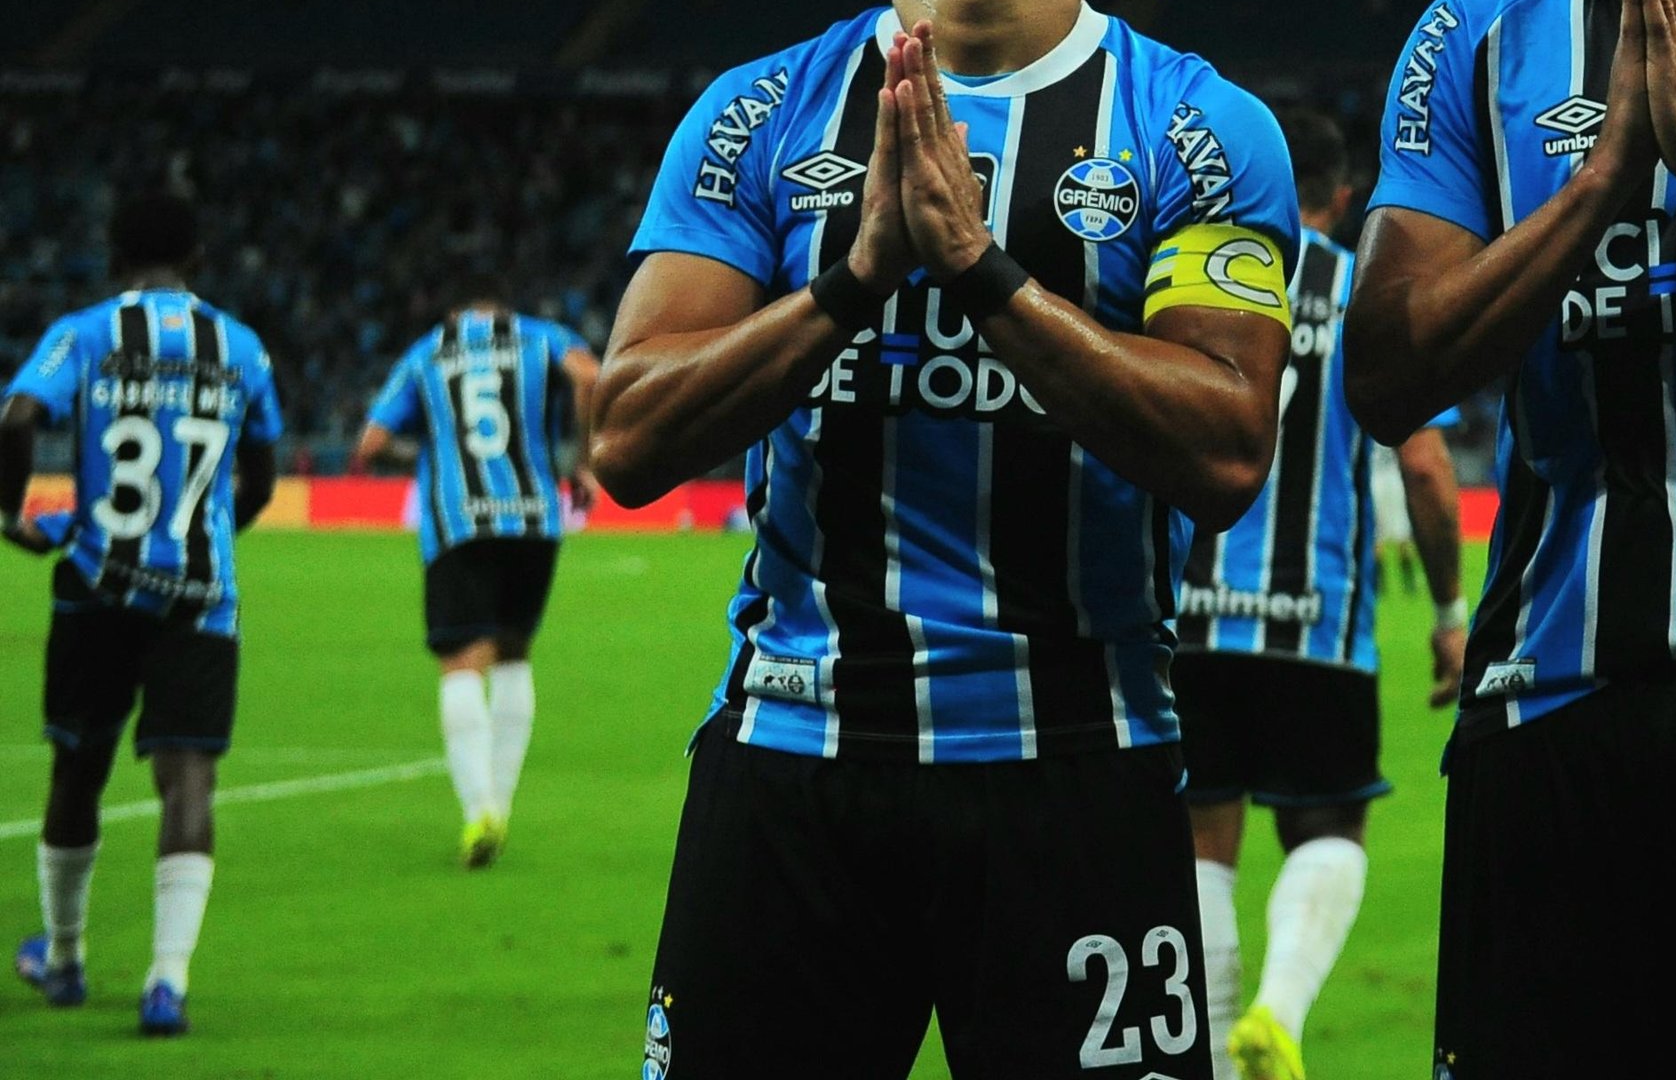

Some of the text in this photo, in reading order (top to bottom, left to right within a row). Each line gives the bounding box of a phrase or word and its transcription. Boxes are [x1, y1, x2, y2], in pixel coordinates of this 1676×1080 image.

[694, 68, 789, 207] HAVAN
[1544, 133, 1598, 156] umbr
[791, 190, 855, 211] umbro
[1059, 187, 1135, 215] GRÊMIO
[1204, 238, 1283, 309] C
[1561, 285, 1628, 343] DE
[460, 370, 511, 459] 5
[92, 415, 230, 541] 37
[1065, 924, 1199, 1071] 23
